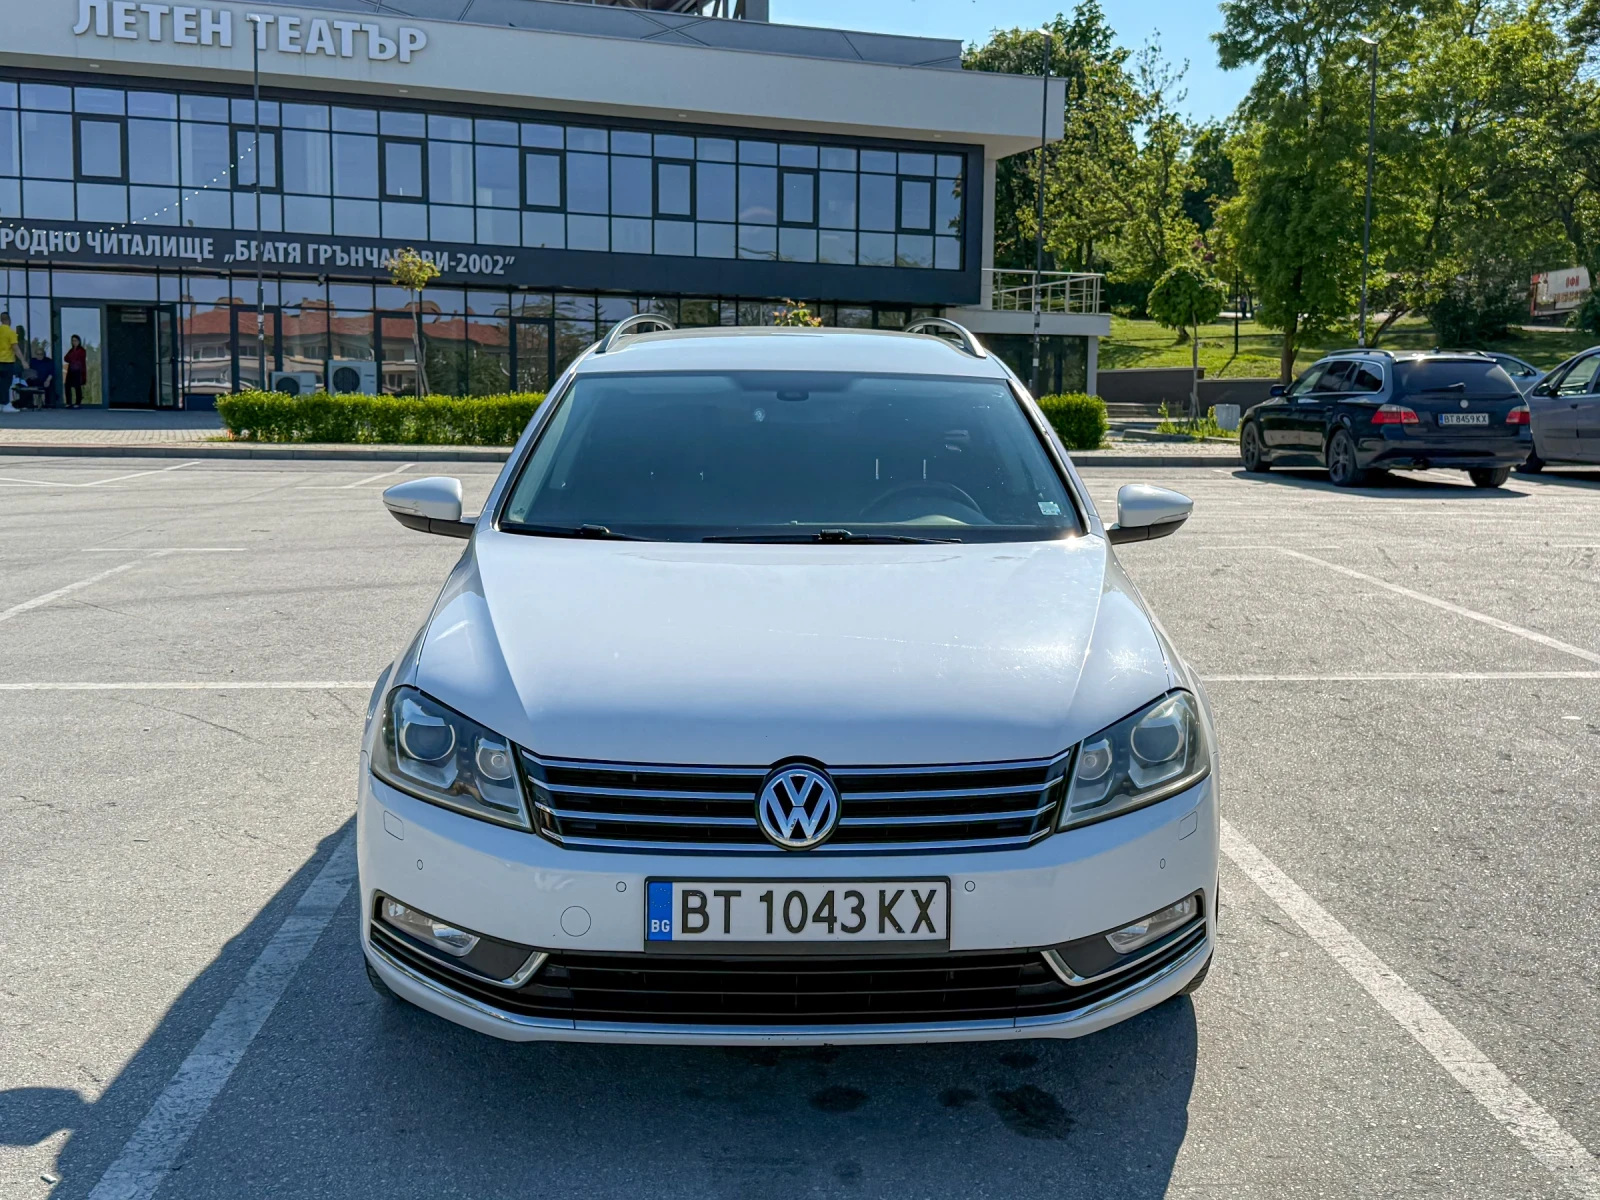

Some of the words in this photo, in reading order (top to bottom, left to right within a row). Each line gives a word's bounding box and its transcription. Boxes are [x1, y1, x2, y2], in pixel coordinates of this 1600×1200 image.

[73, 0, 232, 47] ЛЕТЕН
[246, 13, 427, 63] ТЕАТЪР
[86, 231, 214, 262] ЧИТАЛИЩЕ
[650, 919, 670, 933] BG
[681, 889, 742, 934] BT
[759, 889, 867, 934] 1043
[878, 889, 937, 934] KX
